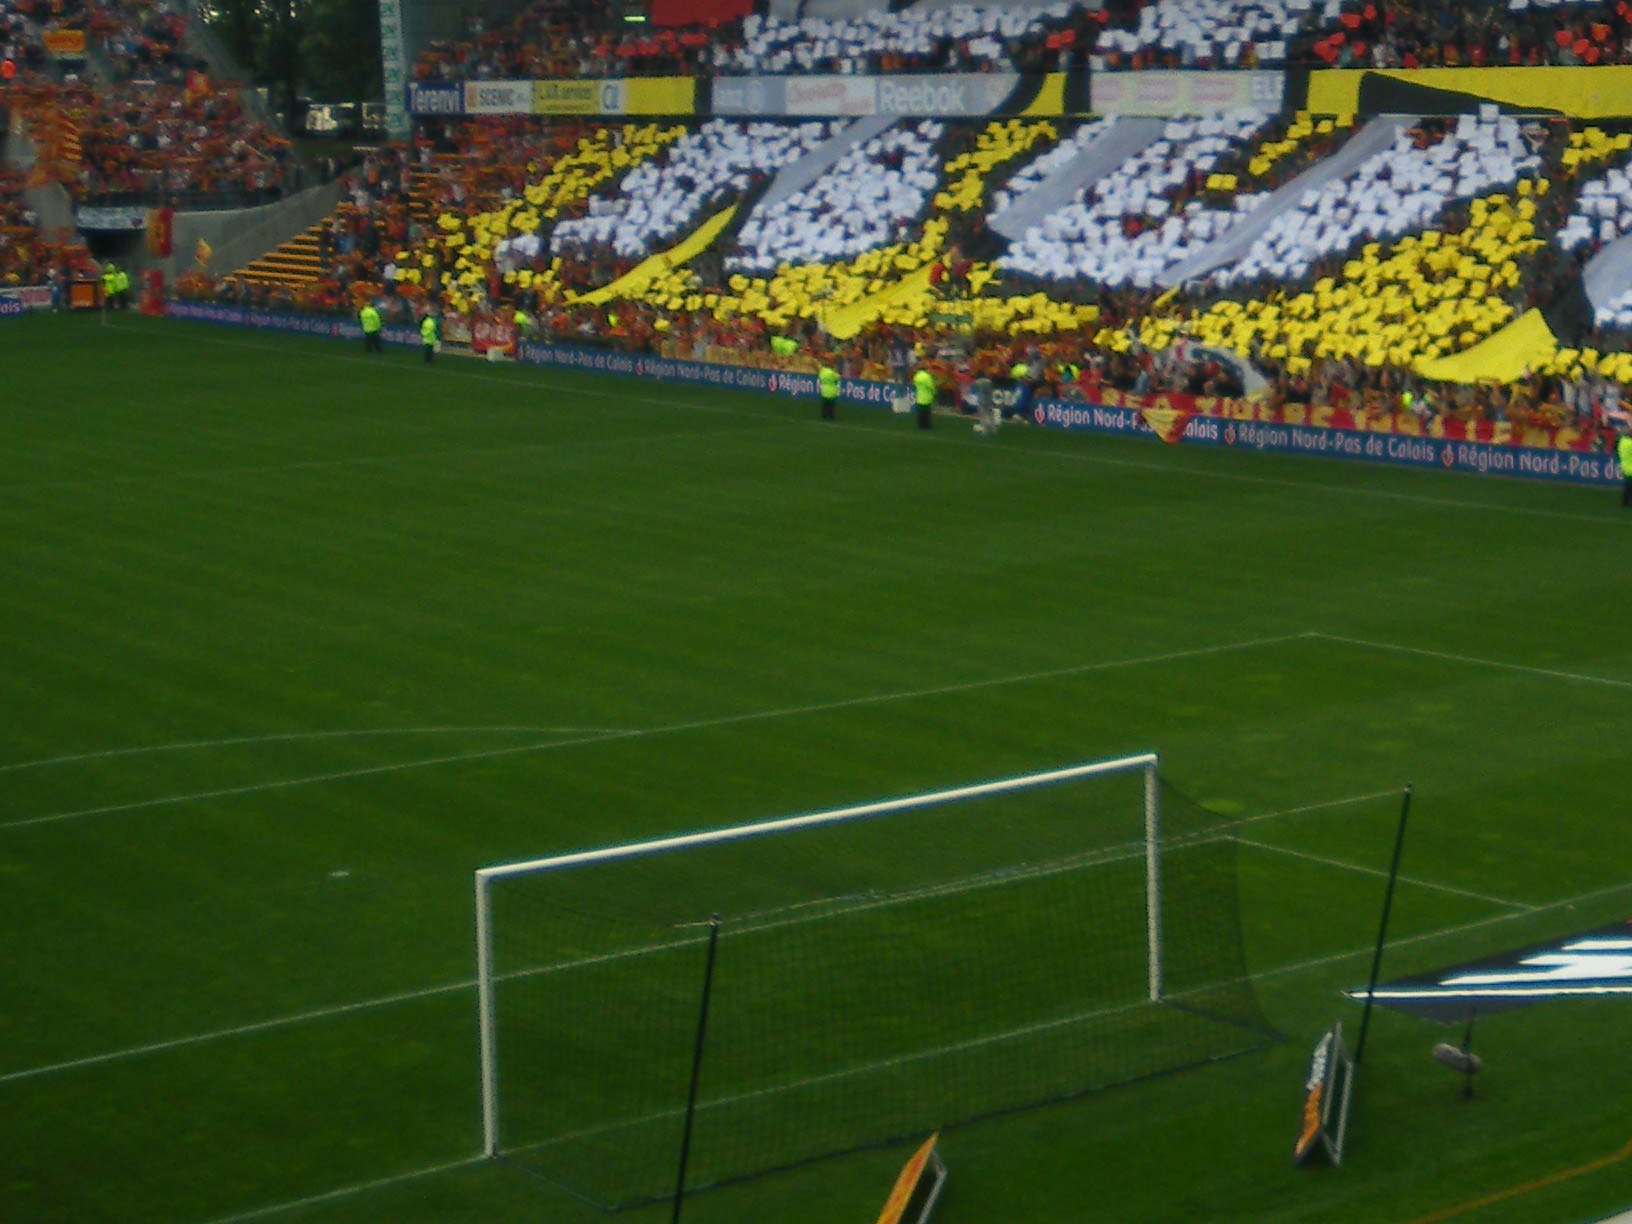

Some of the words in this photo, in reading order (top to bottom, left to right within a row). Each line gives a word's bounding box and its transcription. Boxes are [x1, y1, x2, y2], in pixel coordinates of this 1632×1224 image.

[880, 81, 965, 112] Reebok
[778, 376, 814, 396] Région
[868, 387, 880, 401] de
[1048, 404, 1090, 428] Région
[1183, 423, 1218, 441] alais
[1238, 423, 1288, 449] Région
[1293, 429, 1361, 455] Nord-Pas
[1366, 438, 1383, 456] de
[1388, 441, 1434, 463] Calais
[1458, 445, 1513, 472] Région
[1519, 453, 1600, 478] Nord-Pas
